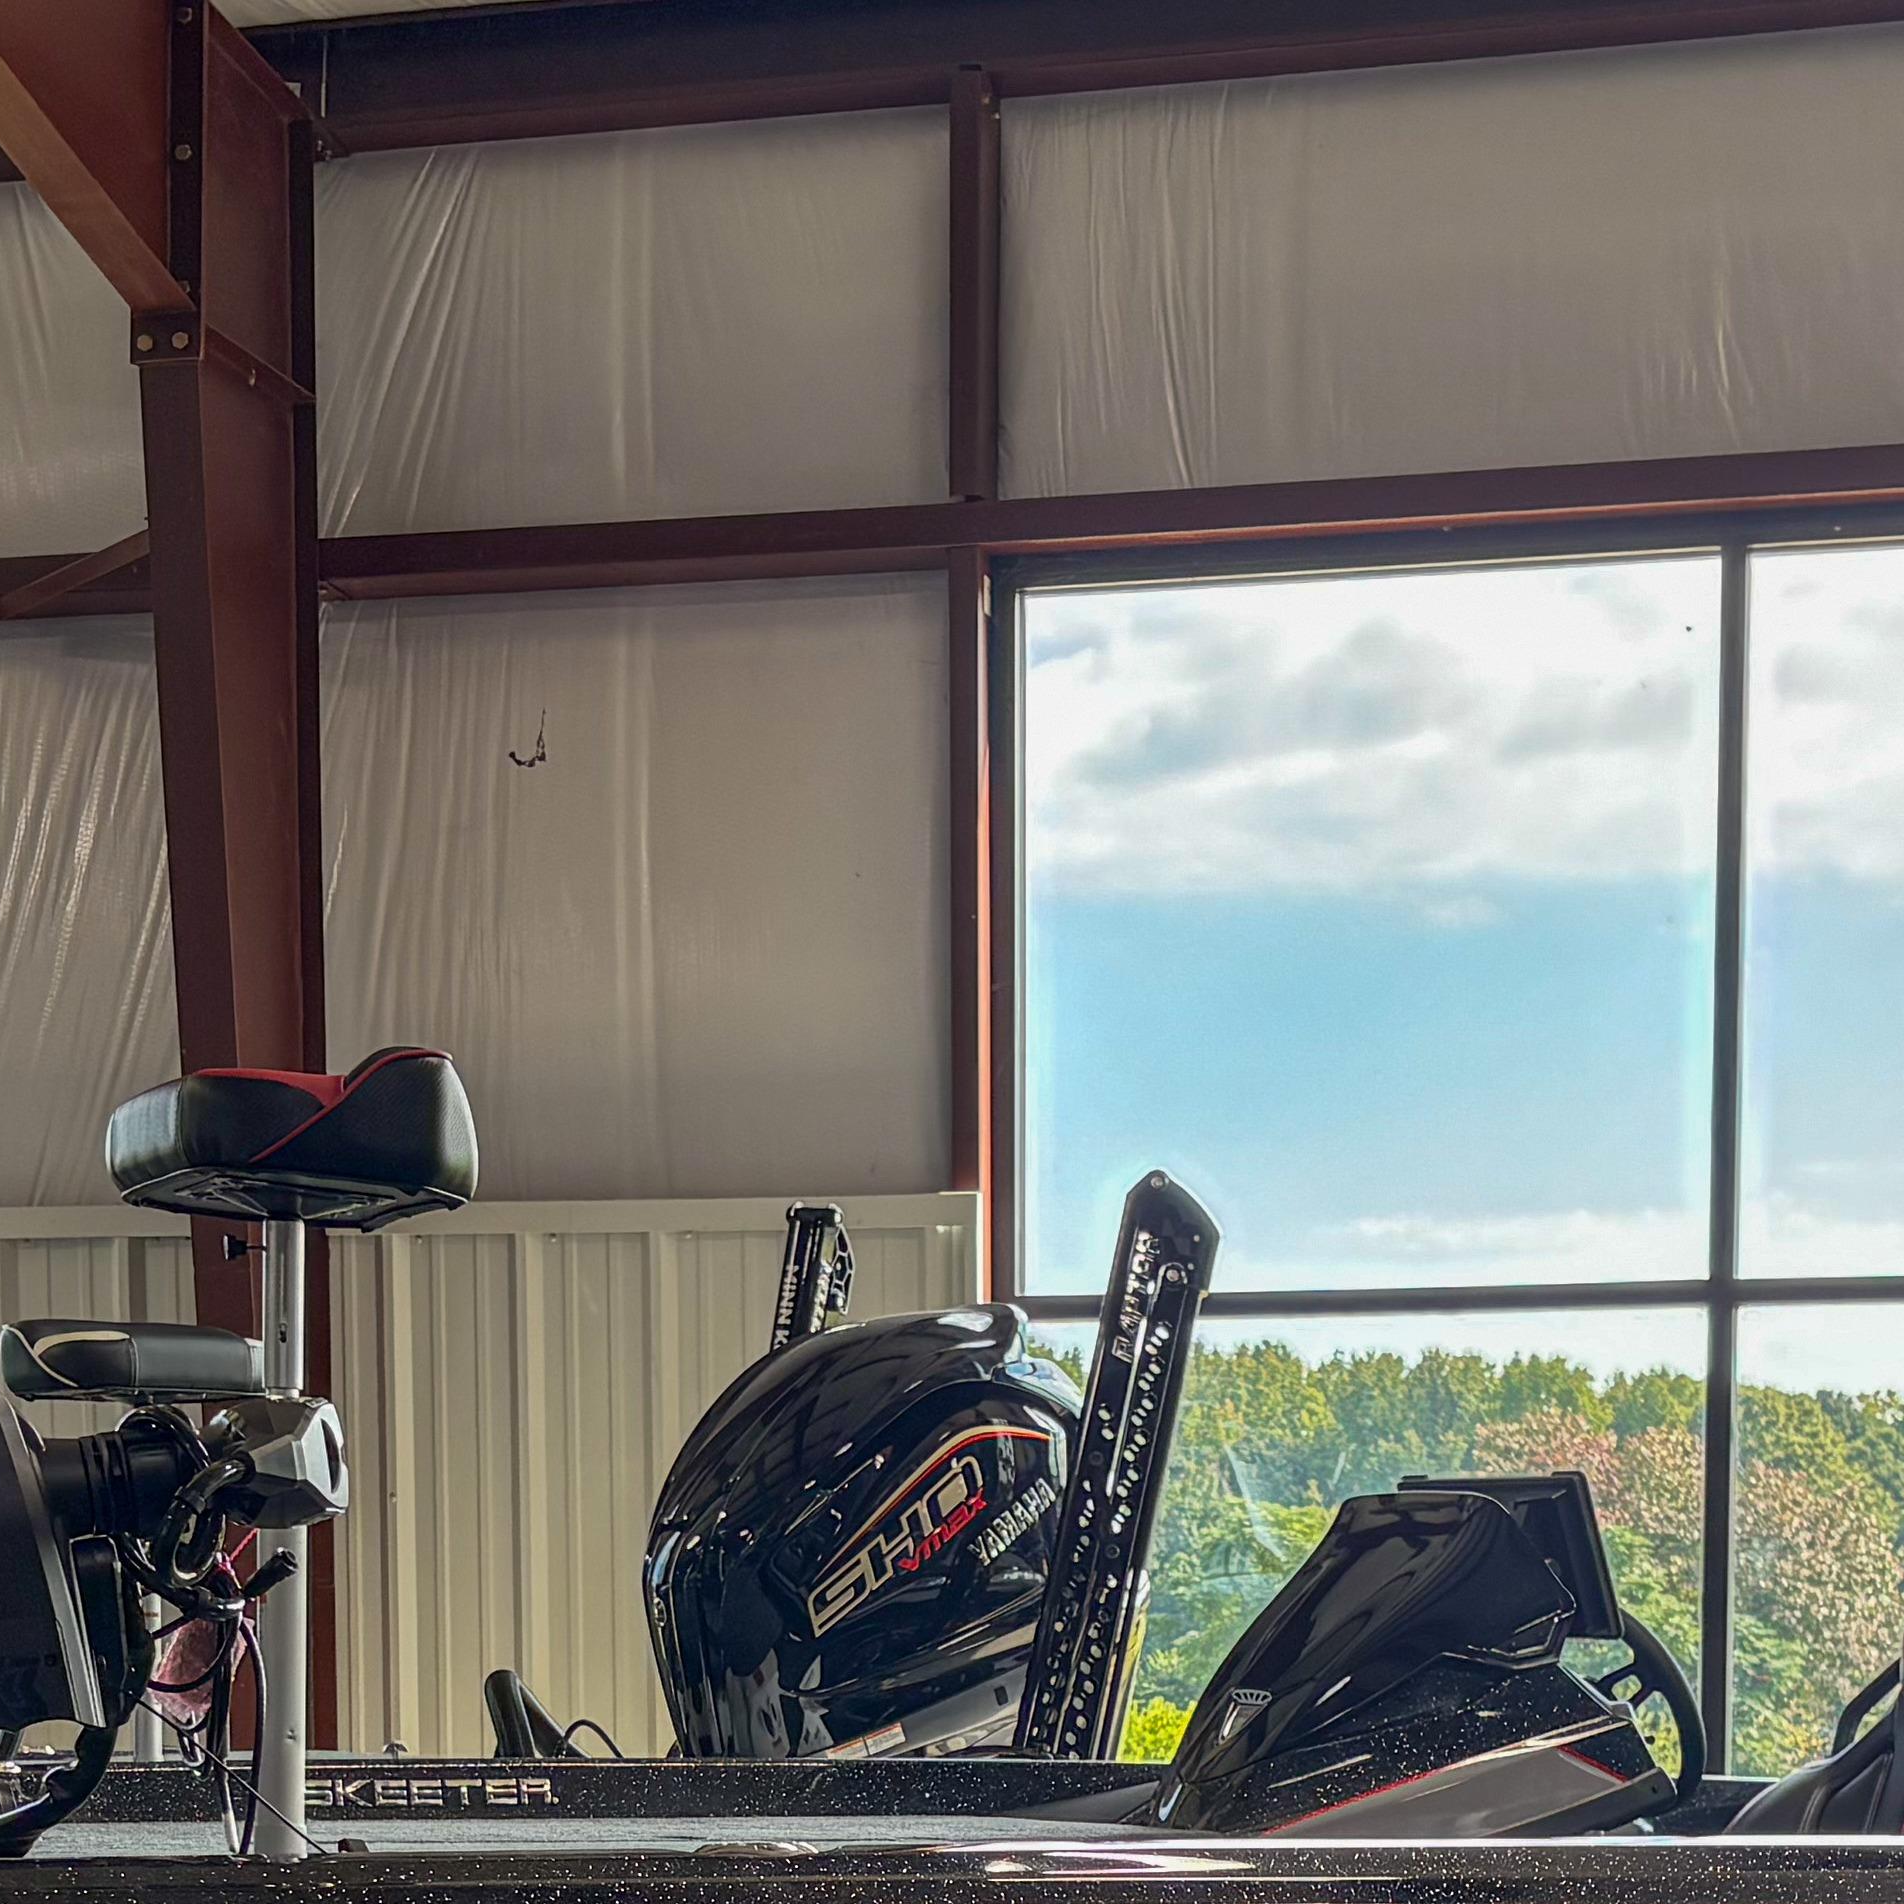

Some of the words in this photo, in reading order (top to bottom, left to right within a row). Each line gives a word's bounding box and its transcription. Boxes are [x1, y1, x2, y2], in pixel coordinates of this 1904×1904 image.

[776, 1264, 800, 1326] MINN
[772, 1328, 791, 1351] K
[807, 1454, 984, 1639] SHO
[966, 1477, 1057, 1567] YAMAHA
[304, 1778, 553, 1808] SKEETER
